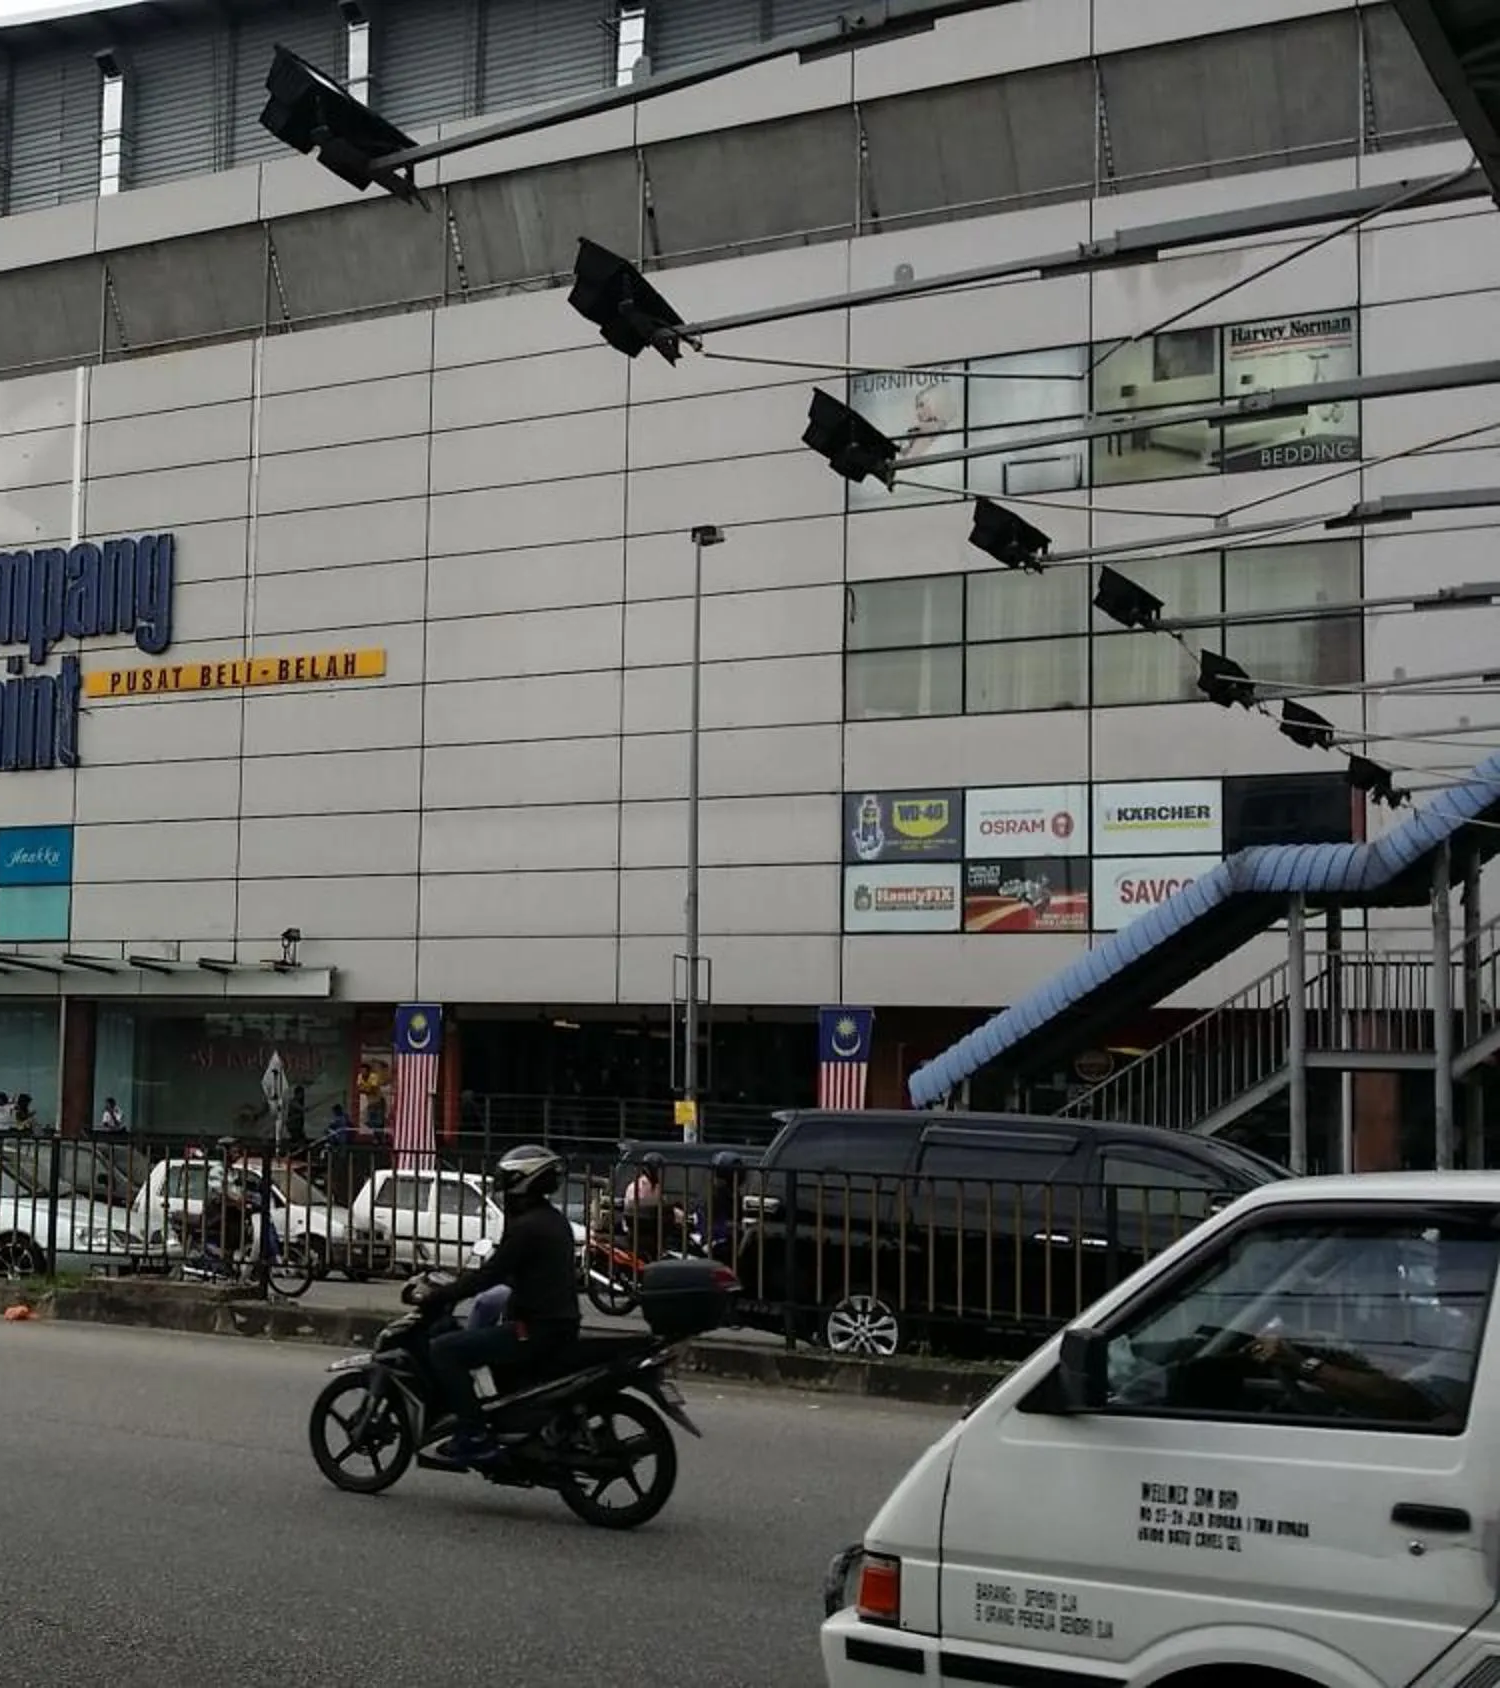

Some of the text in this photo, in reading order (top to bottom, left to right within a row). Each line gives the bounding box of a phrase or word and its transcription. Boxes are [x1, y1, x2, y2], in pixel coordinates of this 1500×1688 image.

[1231, 316, 1350, 343] Harvey Norman
[1260, 441, 1350, 467] BEDDING
[111, 667, 183, 693] PUSAT
[979, 818, 1045, 835] OSRAM
